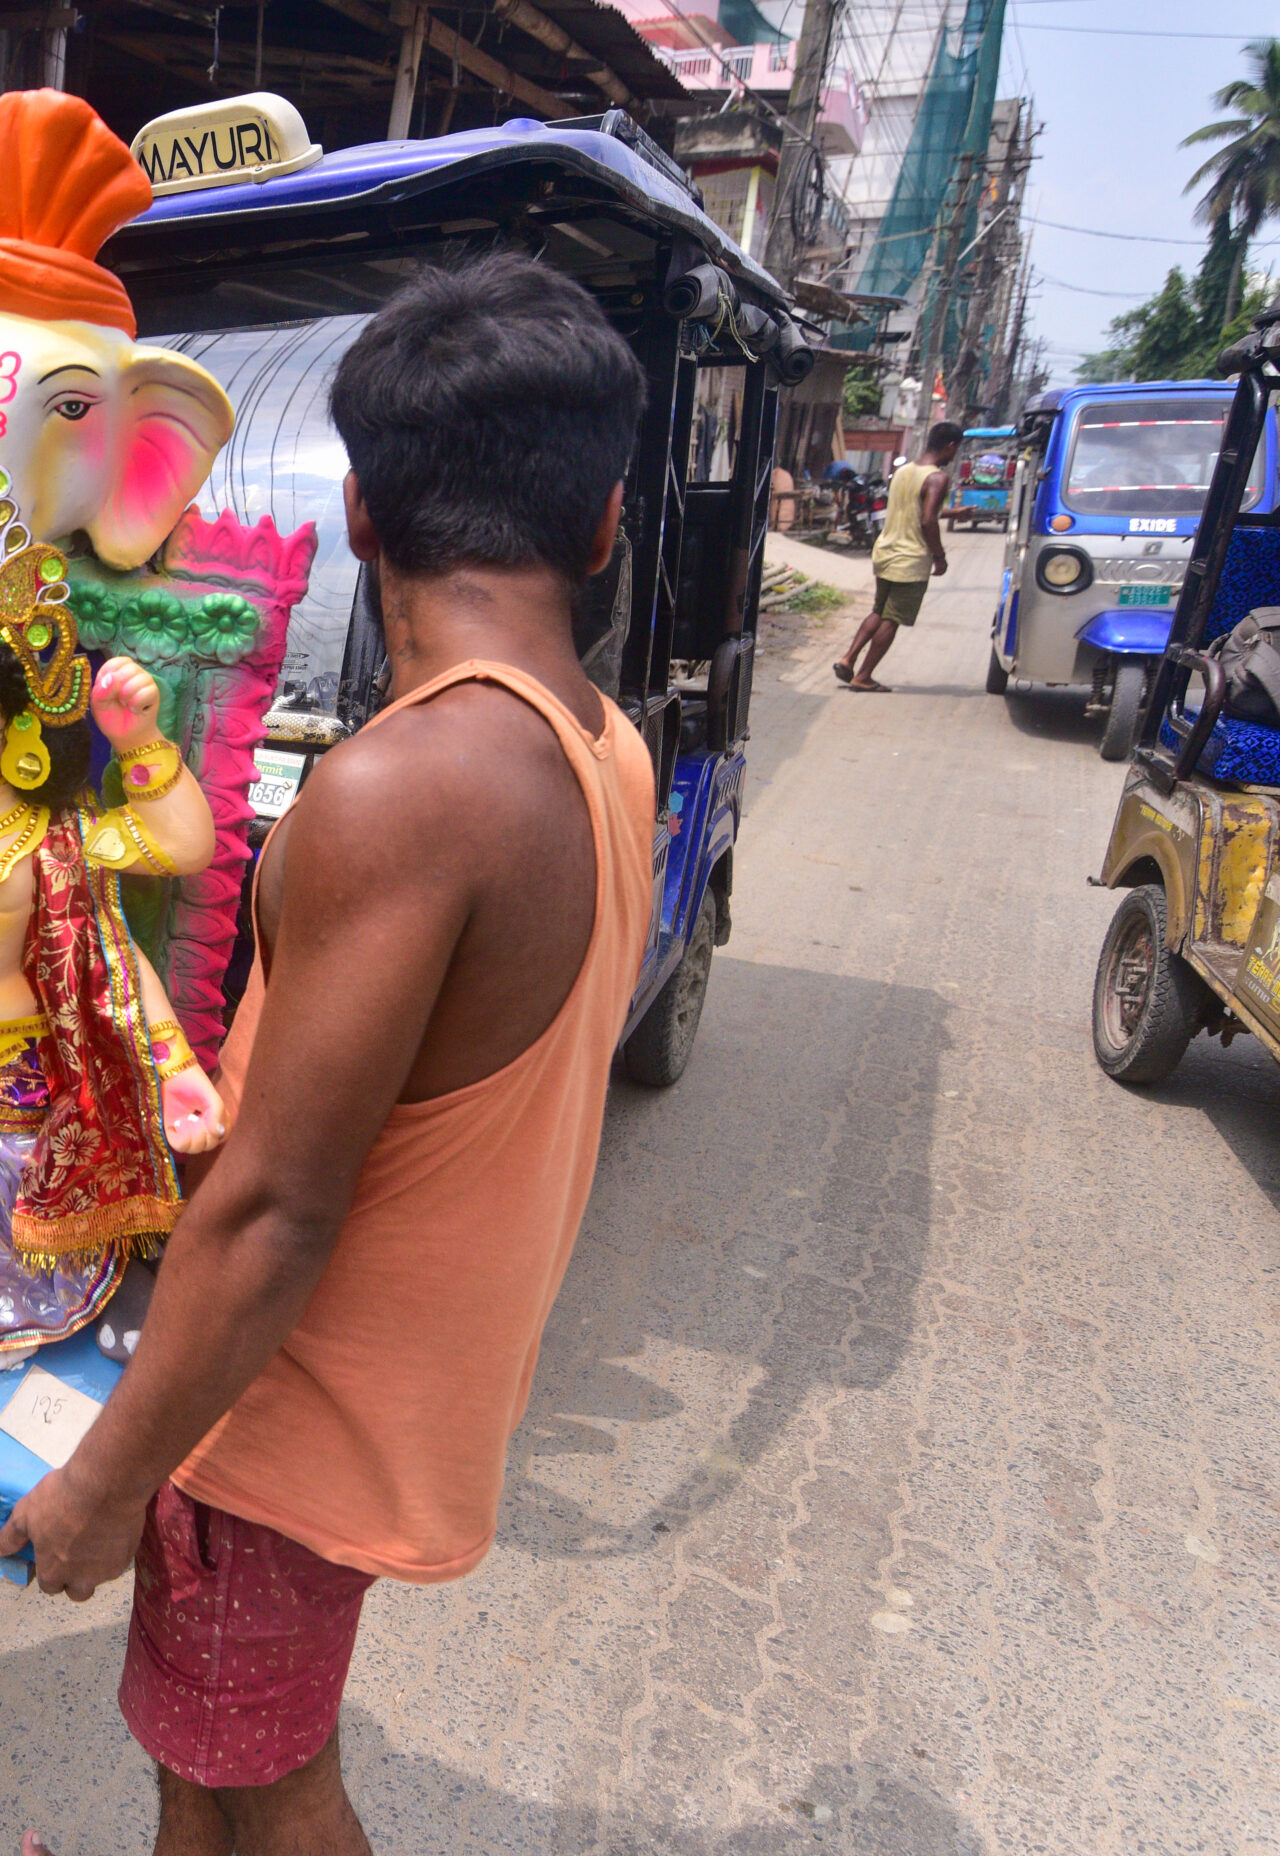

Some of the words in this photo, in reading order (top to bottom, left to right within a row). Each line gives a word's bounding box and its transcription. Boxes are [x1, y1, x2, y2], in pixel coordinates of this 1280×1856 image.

[138, 119, 273, 183] MAYURI
[1129, 518, 1177, 532] EXIDE
[255, 763, 283, 776] ermit
